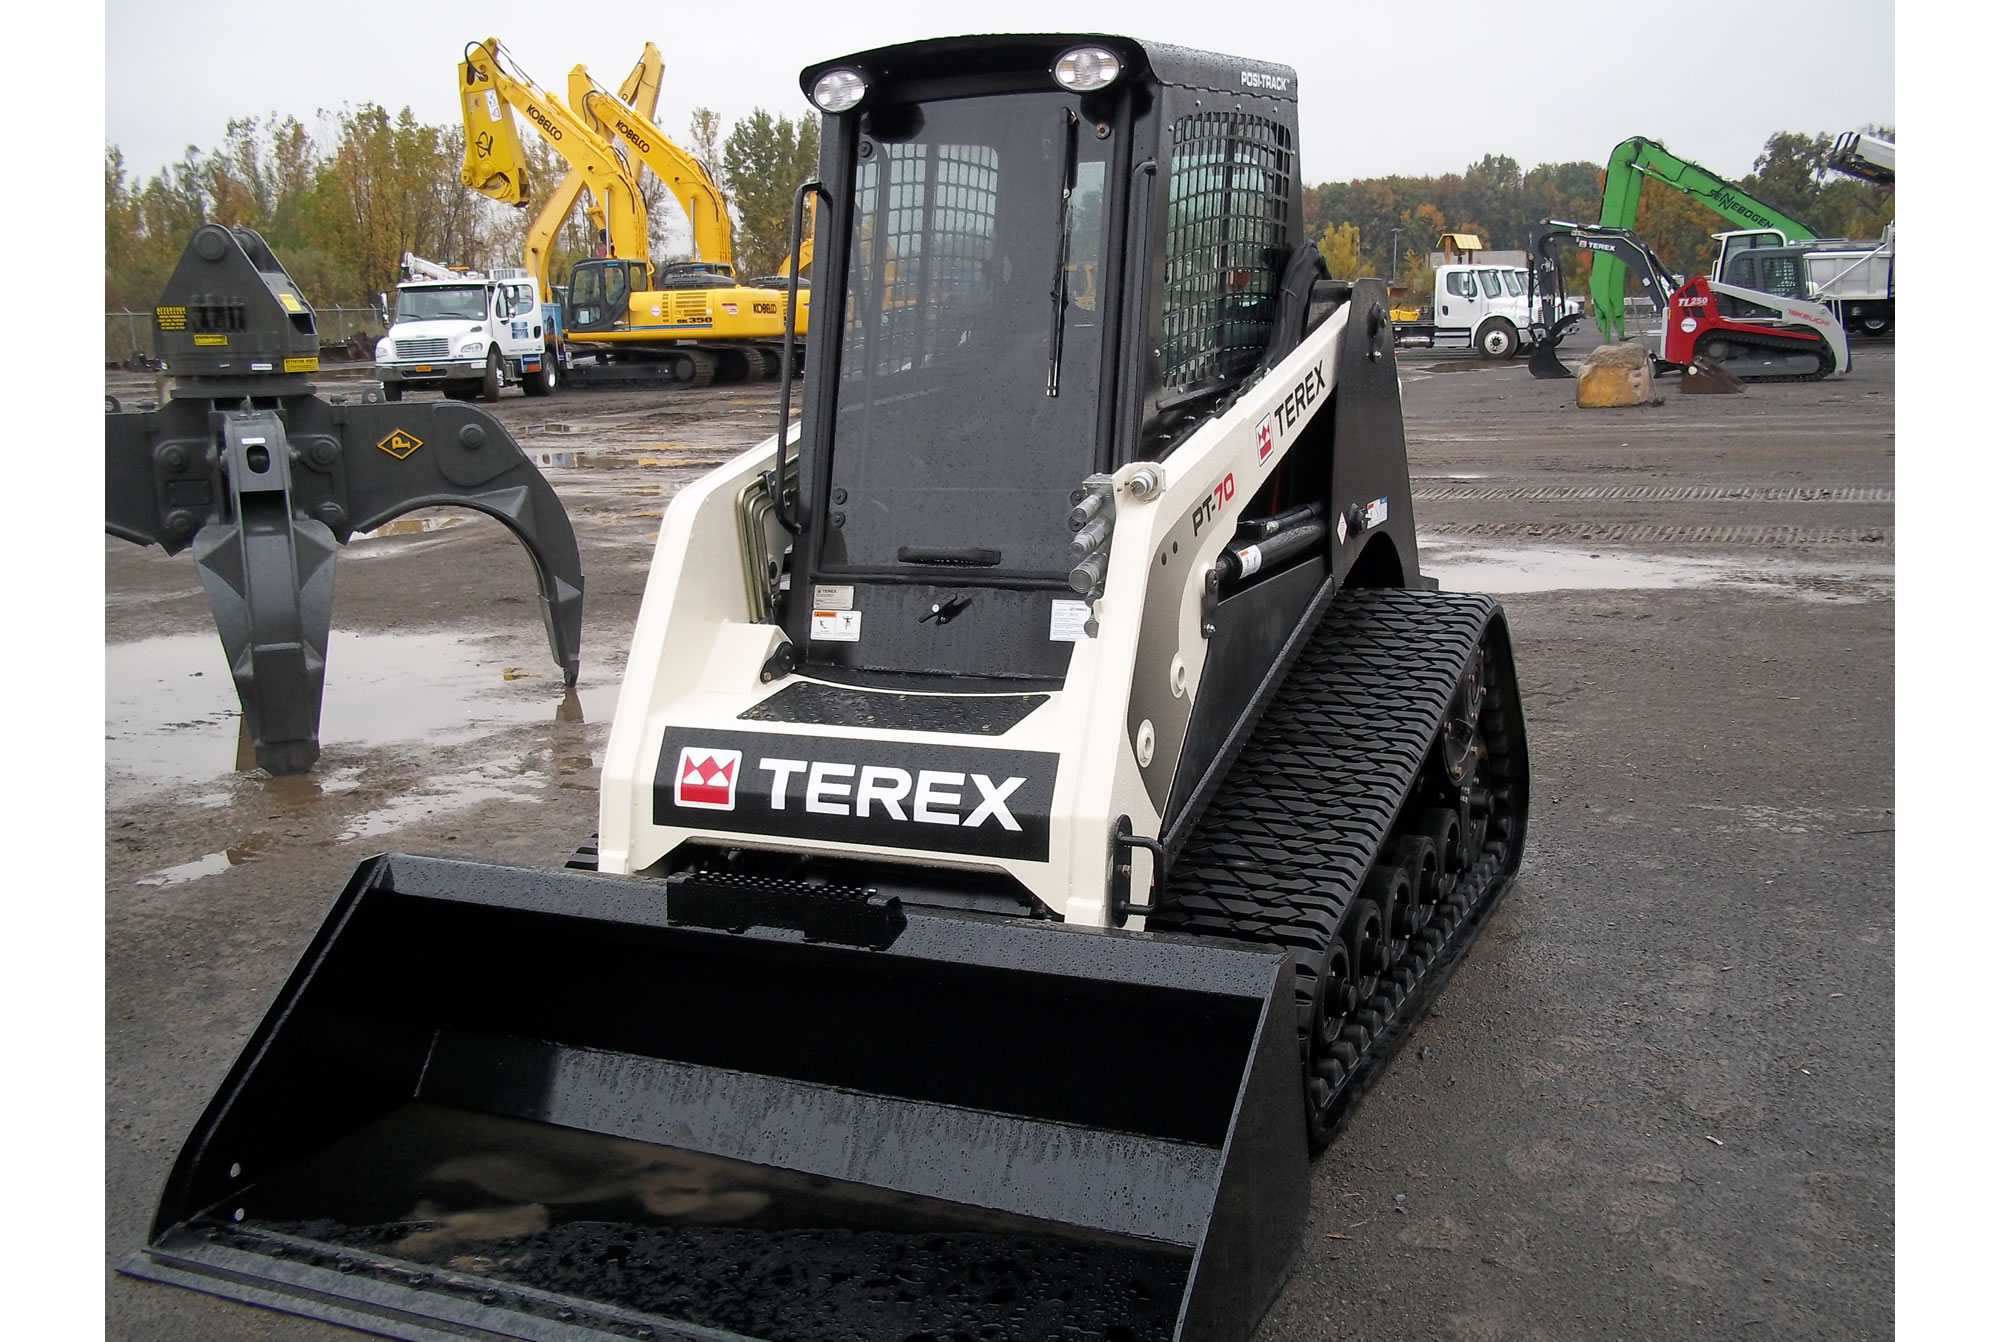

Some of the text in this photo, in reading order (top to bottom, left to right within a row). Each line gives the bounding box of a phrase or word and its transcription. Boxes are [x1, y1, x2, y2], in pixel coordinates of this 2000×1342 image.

[1241, 71, 1287, 91] POSI-TRACK
[526, 104, 563, 141] KOBELCO
[615, 119, 650, 153] KOBELCO
[1710, 189, 1774, 228] SENNEBOGEN
[1589, 241, 1616, 252] TEREX
[753, 303, 777, 314] KOBELCO
[1678, 297, 1708, 307] TL250
[1274, 360, 1326, 437] TEREX
[1192, 472, 1235, 538] PT-70
[759, 757, 1028, 832] TEREX
